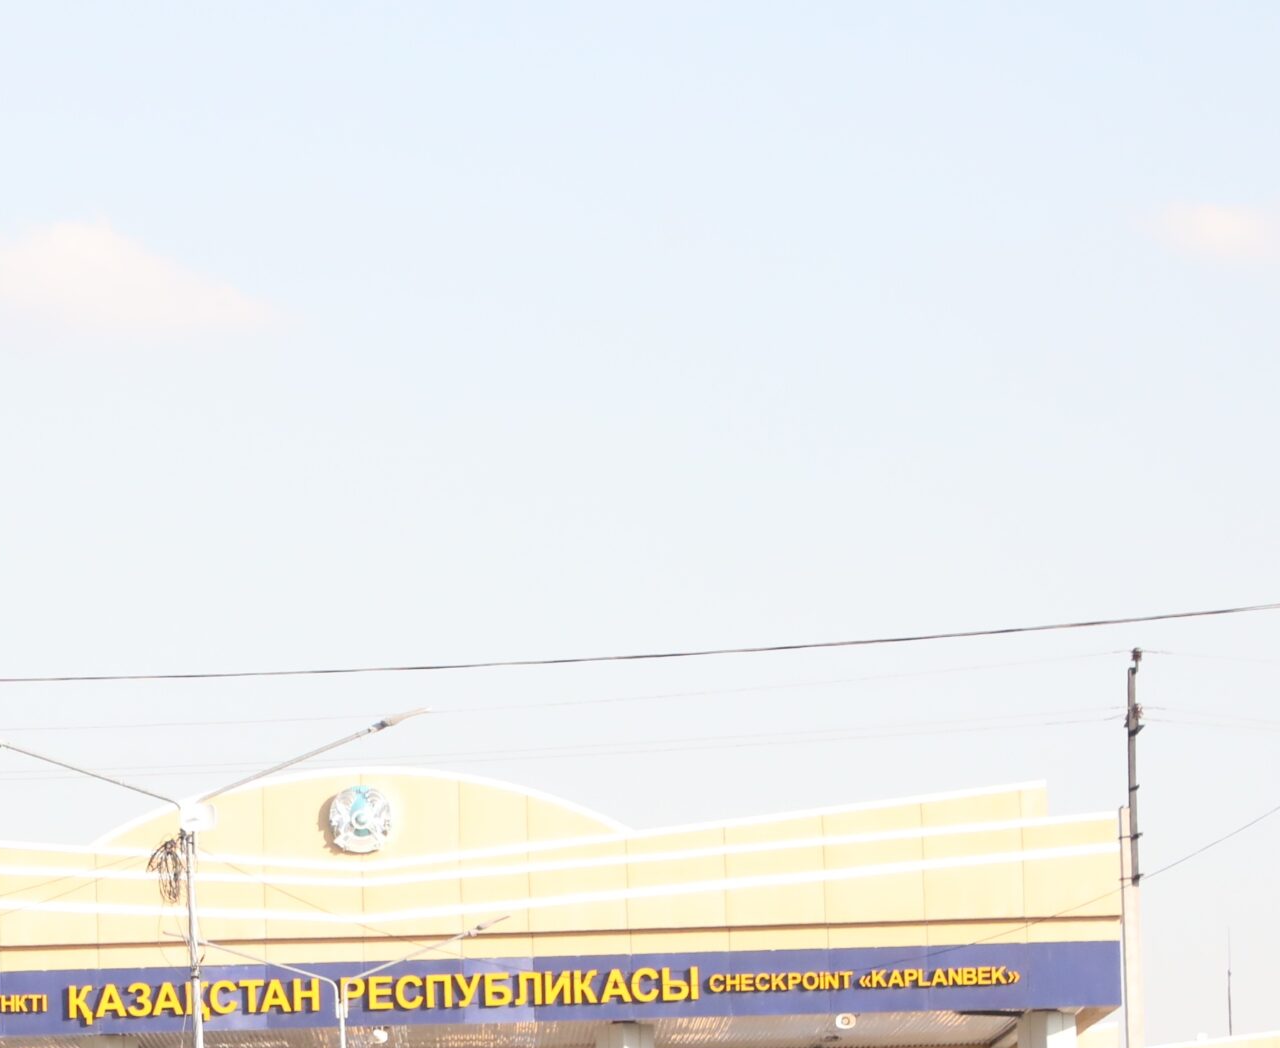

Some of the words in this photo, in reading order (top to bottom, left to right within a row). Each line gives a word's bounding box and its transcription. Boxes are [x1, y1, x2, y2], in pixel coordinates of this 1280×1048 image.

[340, 965, 699, 1010] РЕСПУБЛИКАСЫ
[708, 970, 853, 993] CHECKPOINT
[859, 965, 1021, 987] «KAPLANBEK»
